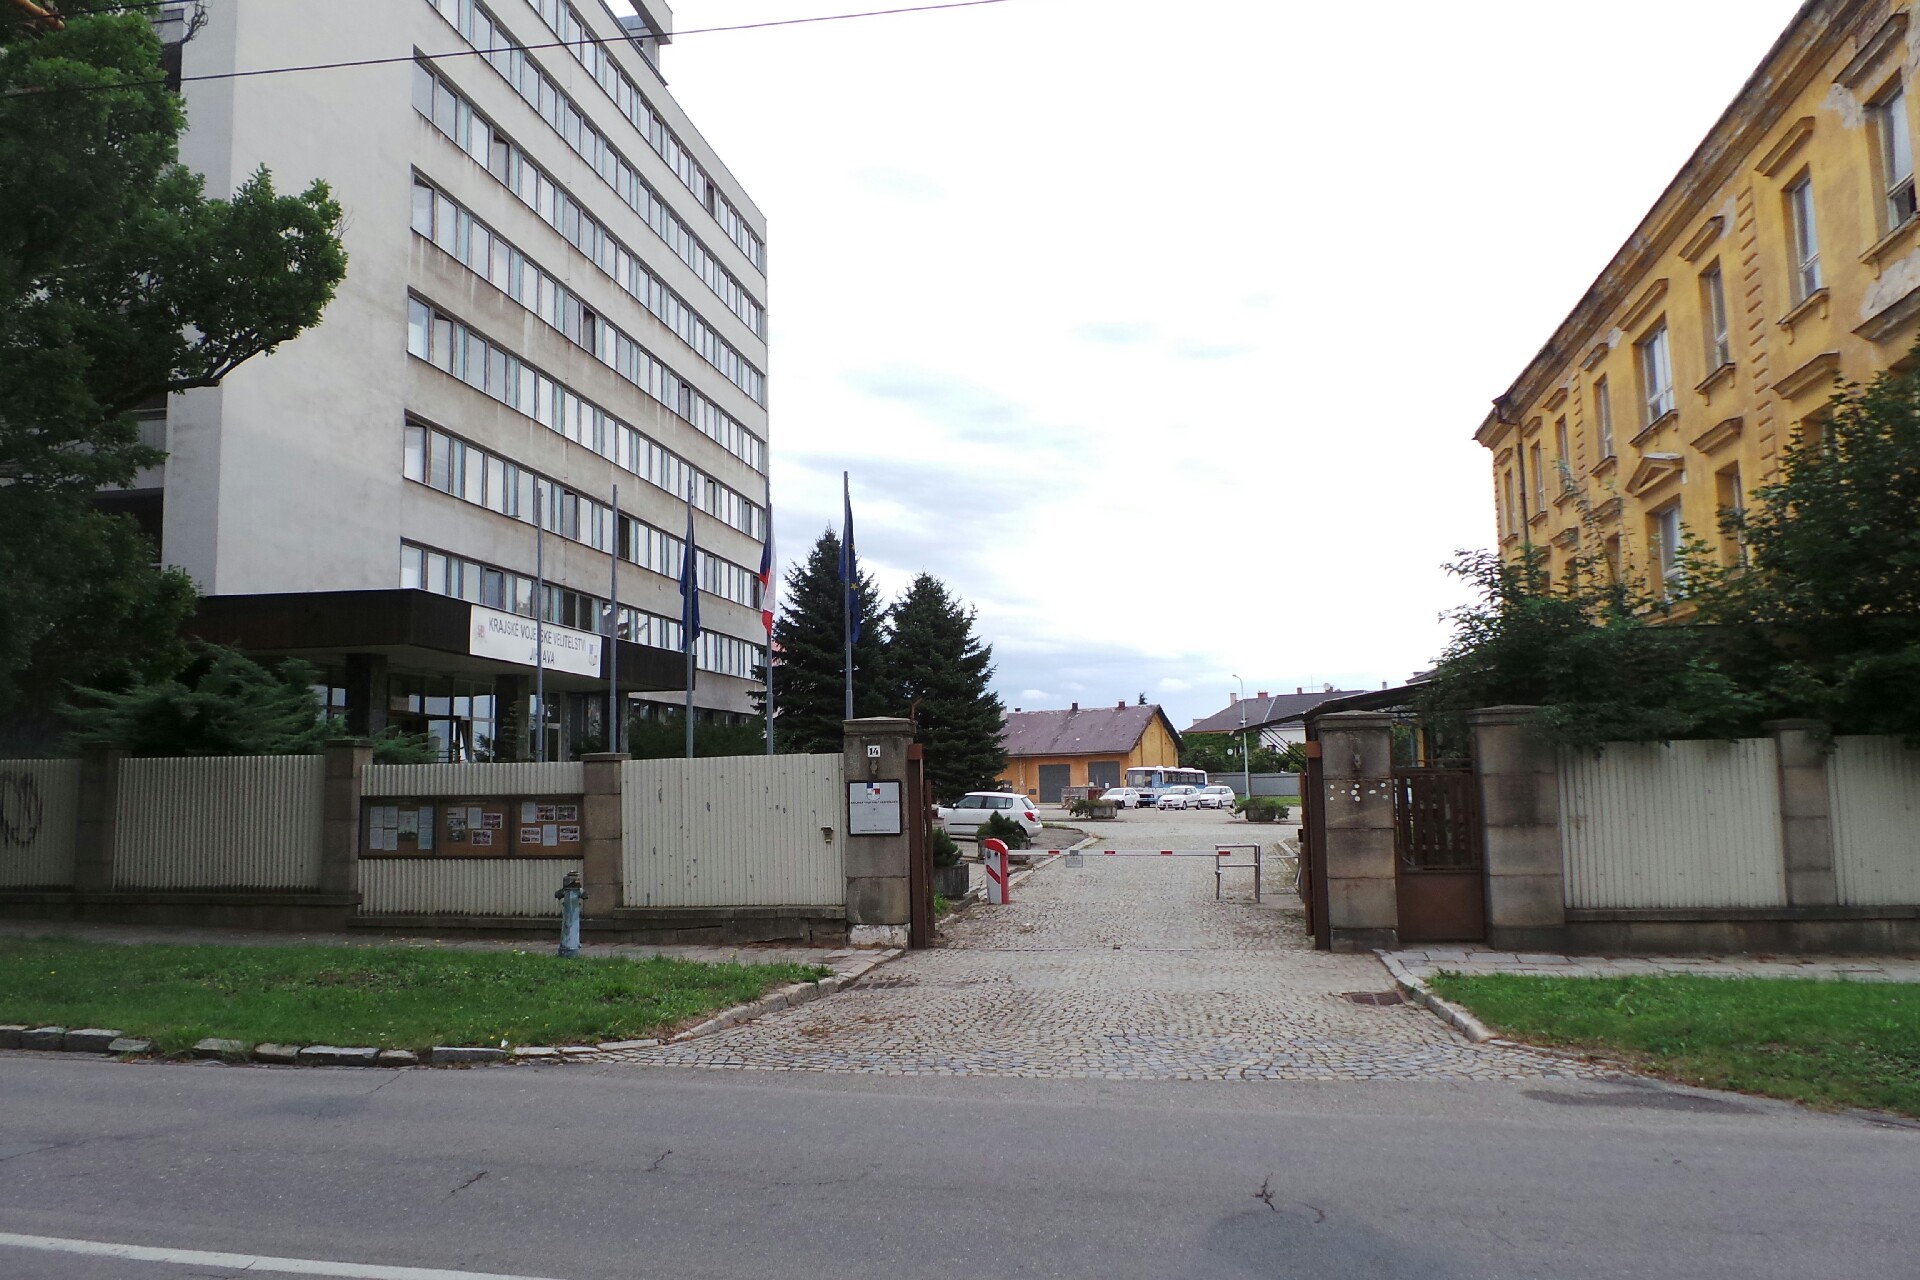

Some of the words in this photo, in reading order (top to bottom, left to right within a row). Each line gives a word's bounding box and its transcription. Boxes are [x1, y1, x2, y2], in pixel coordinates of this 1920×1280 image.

[489, 617, 519, 637] KRAJSKÉ
[520, 624, 552, 645] VOJESKÉ
[869, 747, 879, 756] 14
